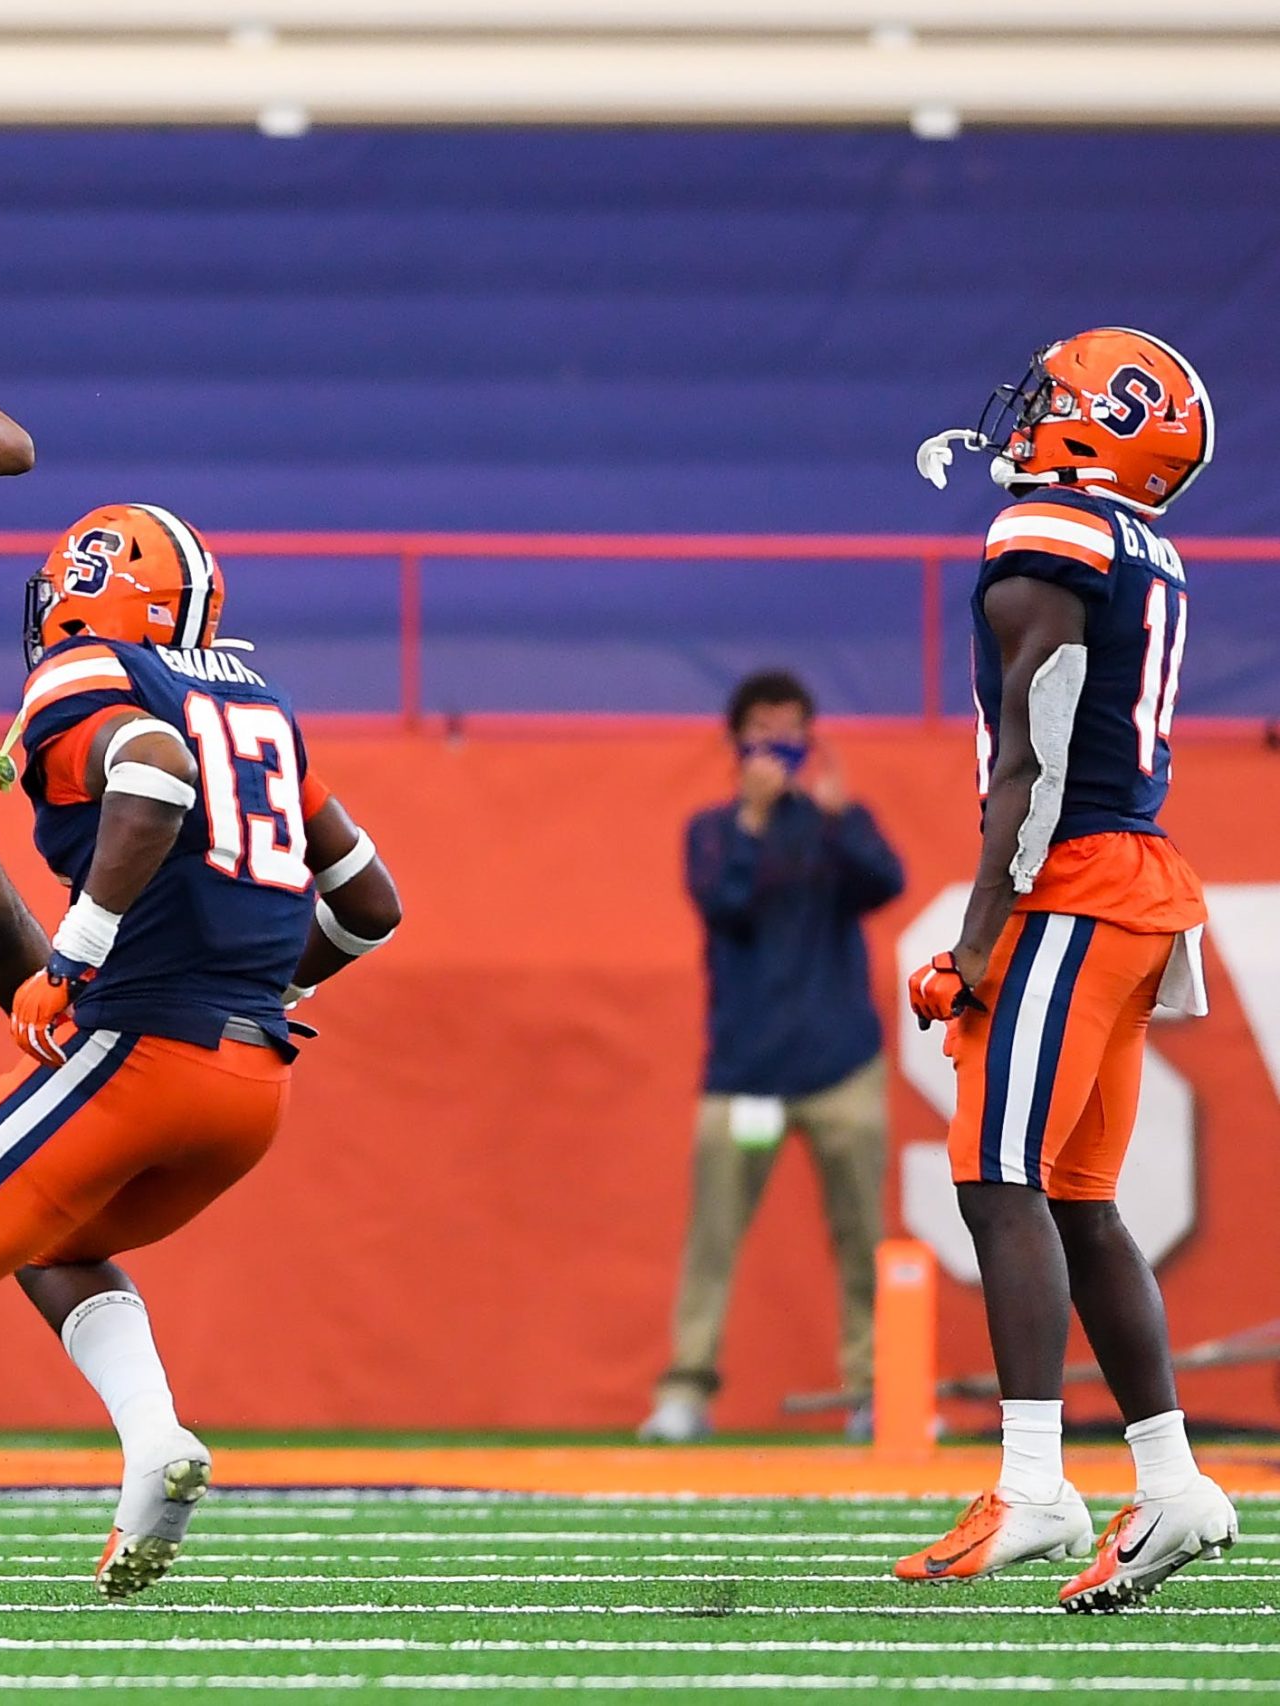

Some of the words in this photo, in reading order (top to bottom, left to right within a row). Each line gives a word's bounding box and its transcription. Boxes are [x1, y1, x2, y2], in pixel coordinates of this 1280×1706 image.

[1096, 365, 1163, 438] S
[65, 528, 124, 598] S
[184, 692, 314, 892] 13
